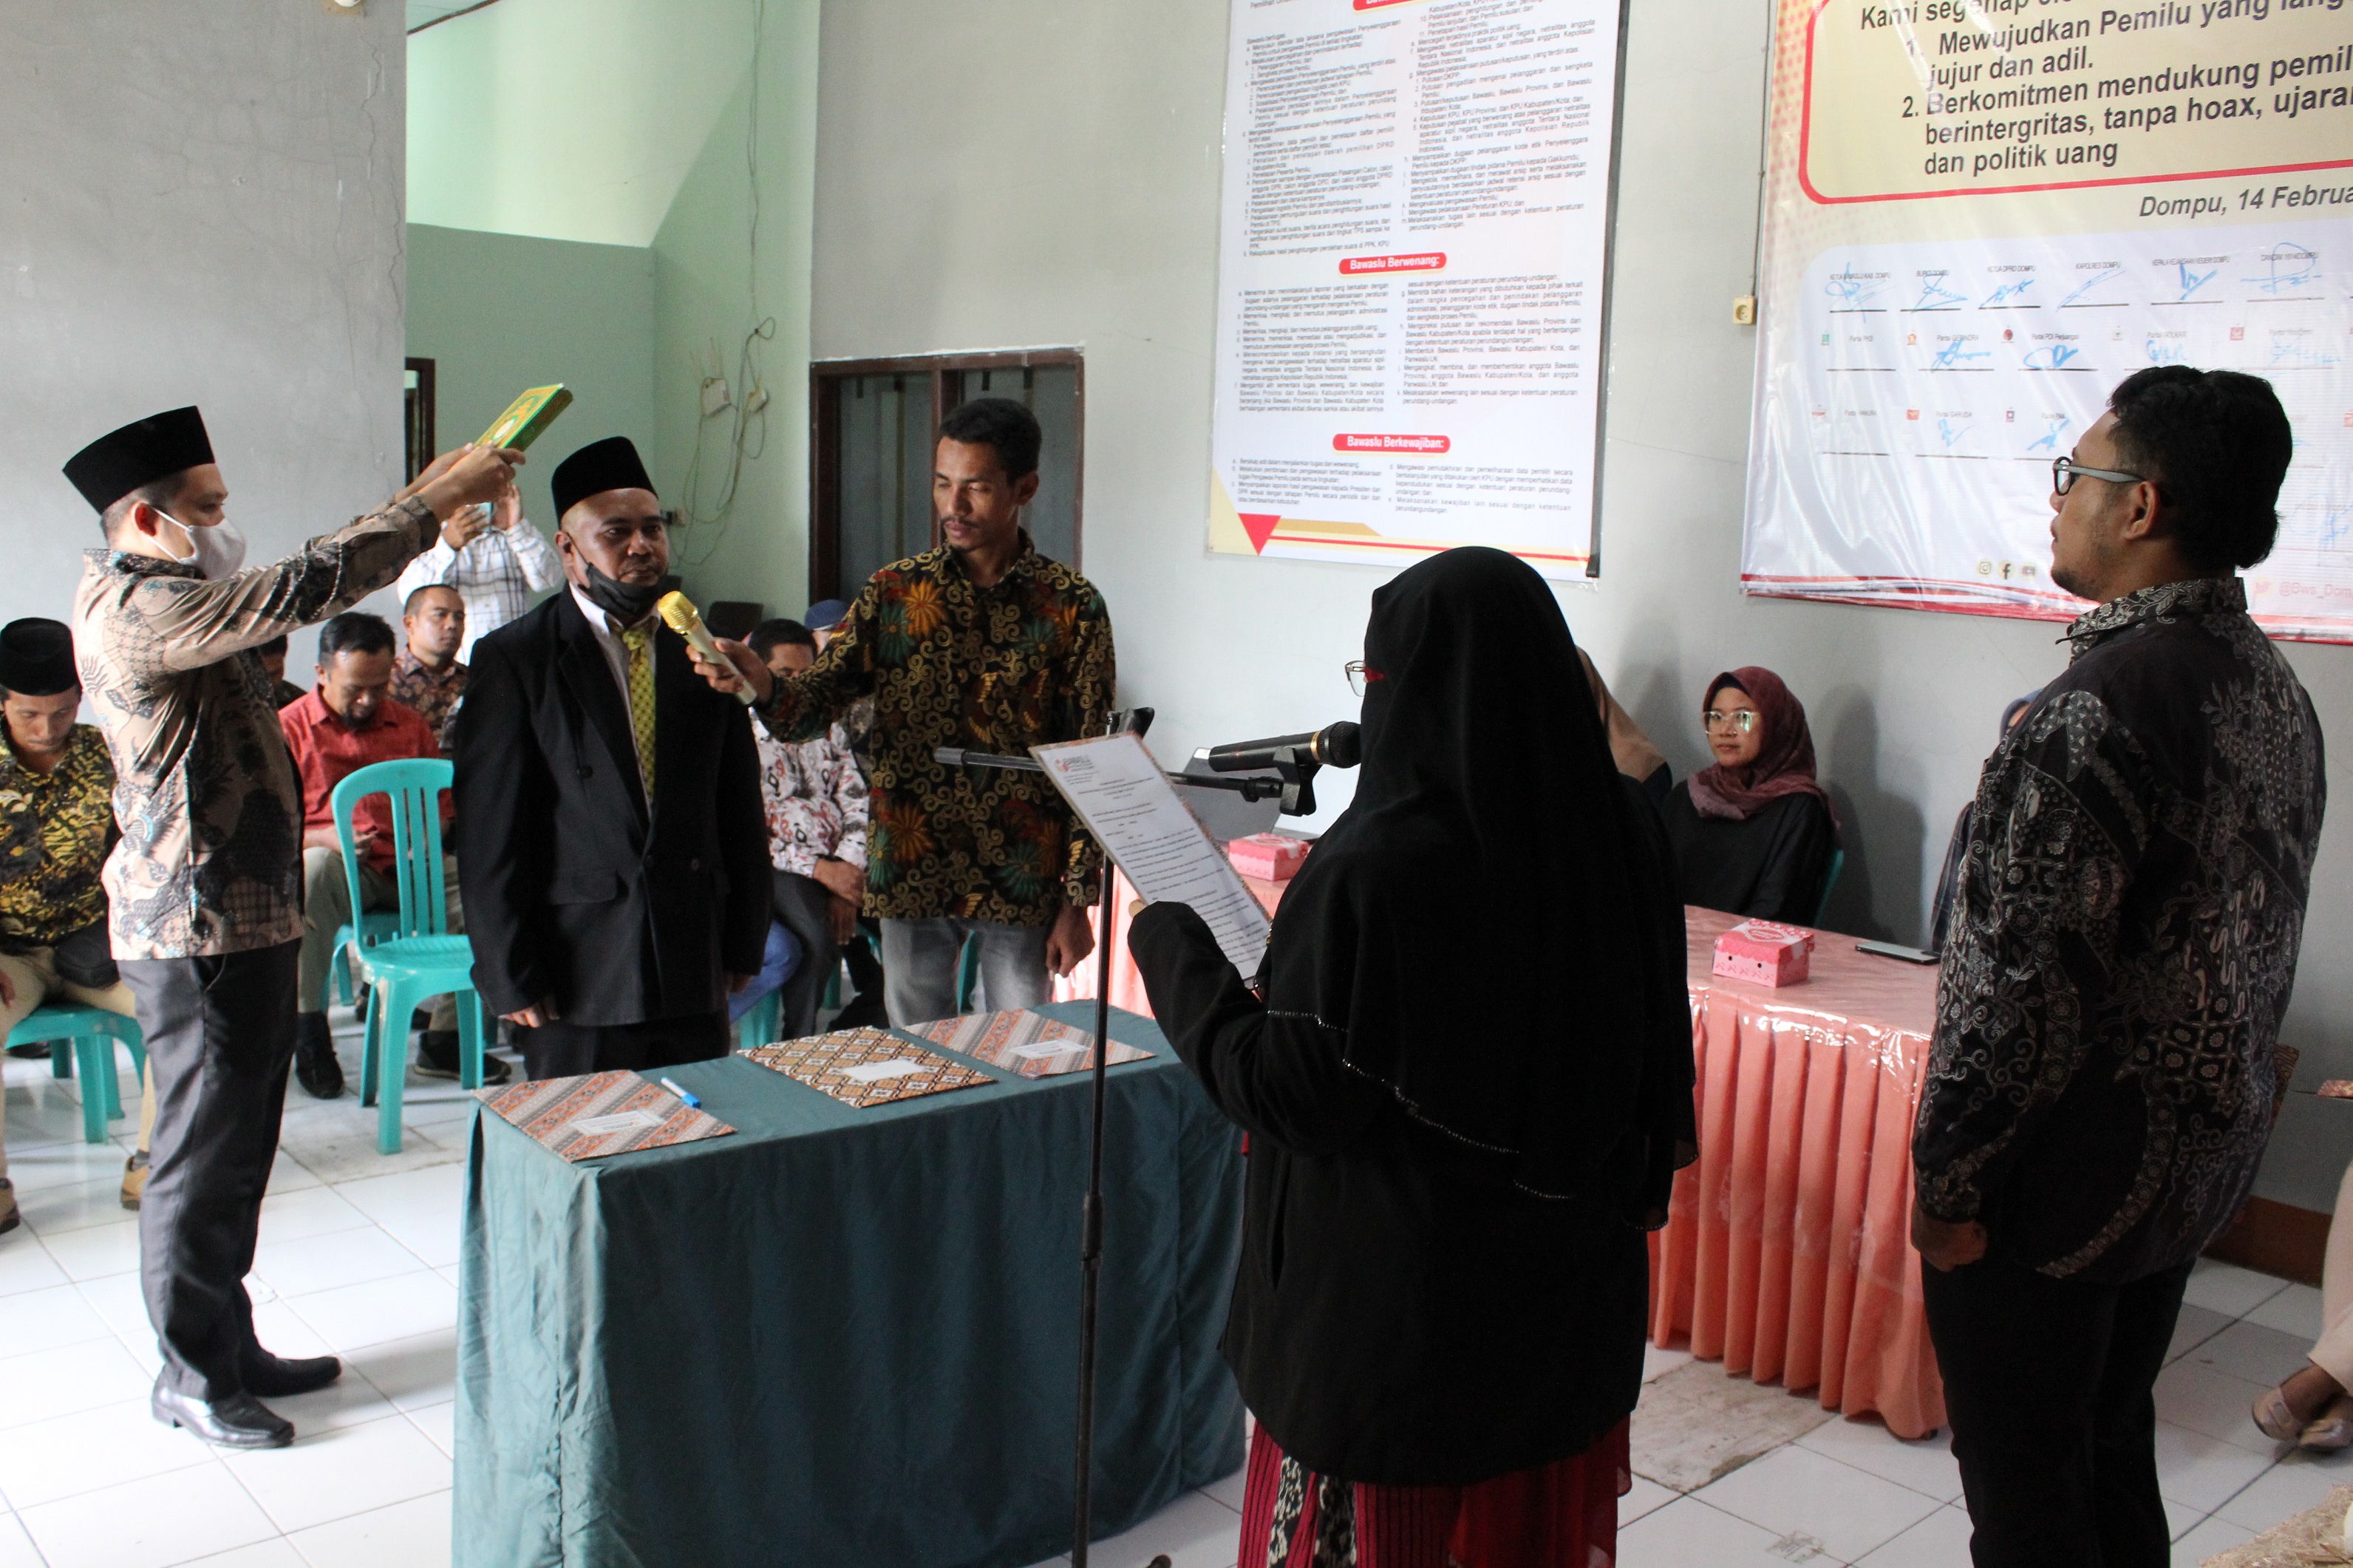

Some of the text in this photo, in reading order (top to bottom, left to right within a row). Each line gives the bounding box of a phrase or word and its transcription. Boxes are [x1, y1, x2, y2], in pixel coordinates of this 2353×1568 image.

[1861, 1, 1917, 30] Kami
[1939, 18, 2090, 55] Mewujudkan
[2100, 1, 2191, 35] Pemilu
[2200, 0, 2269, 28] yang
[1927, 45, 2094, 92] jujur dan adil.
[1901, 95, 1918, 118] 2.
[1927, 82, 2088, 115] Berkomitmen
[2097, 64, 2260, 99] mendukung
[1926, 84, 2353, 145] berintergritas, tanpa hoax, ujara
[1924, 142, 2118, 177] dan politik uang
[2139, 196, 2227, 219] Dompu,
[2238, 188, 2265, 211] 14
[1350, 256, 1440, 270] Bawaslu Berwenang:
[1347, 436, 1444, 450] Bawaslu Berkewajiban:
